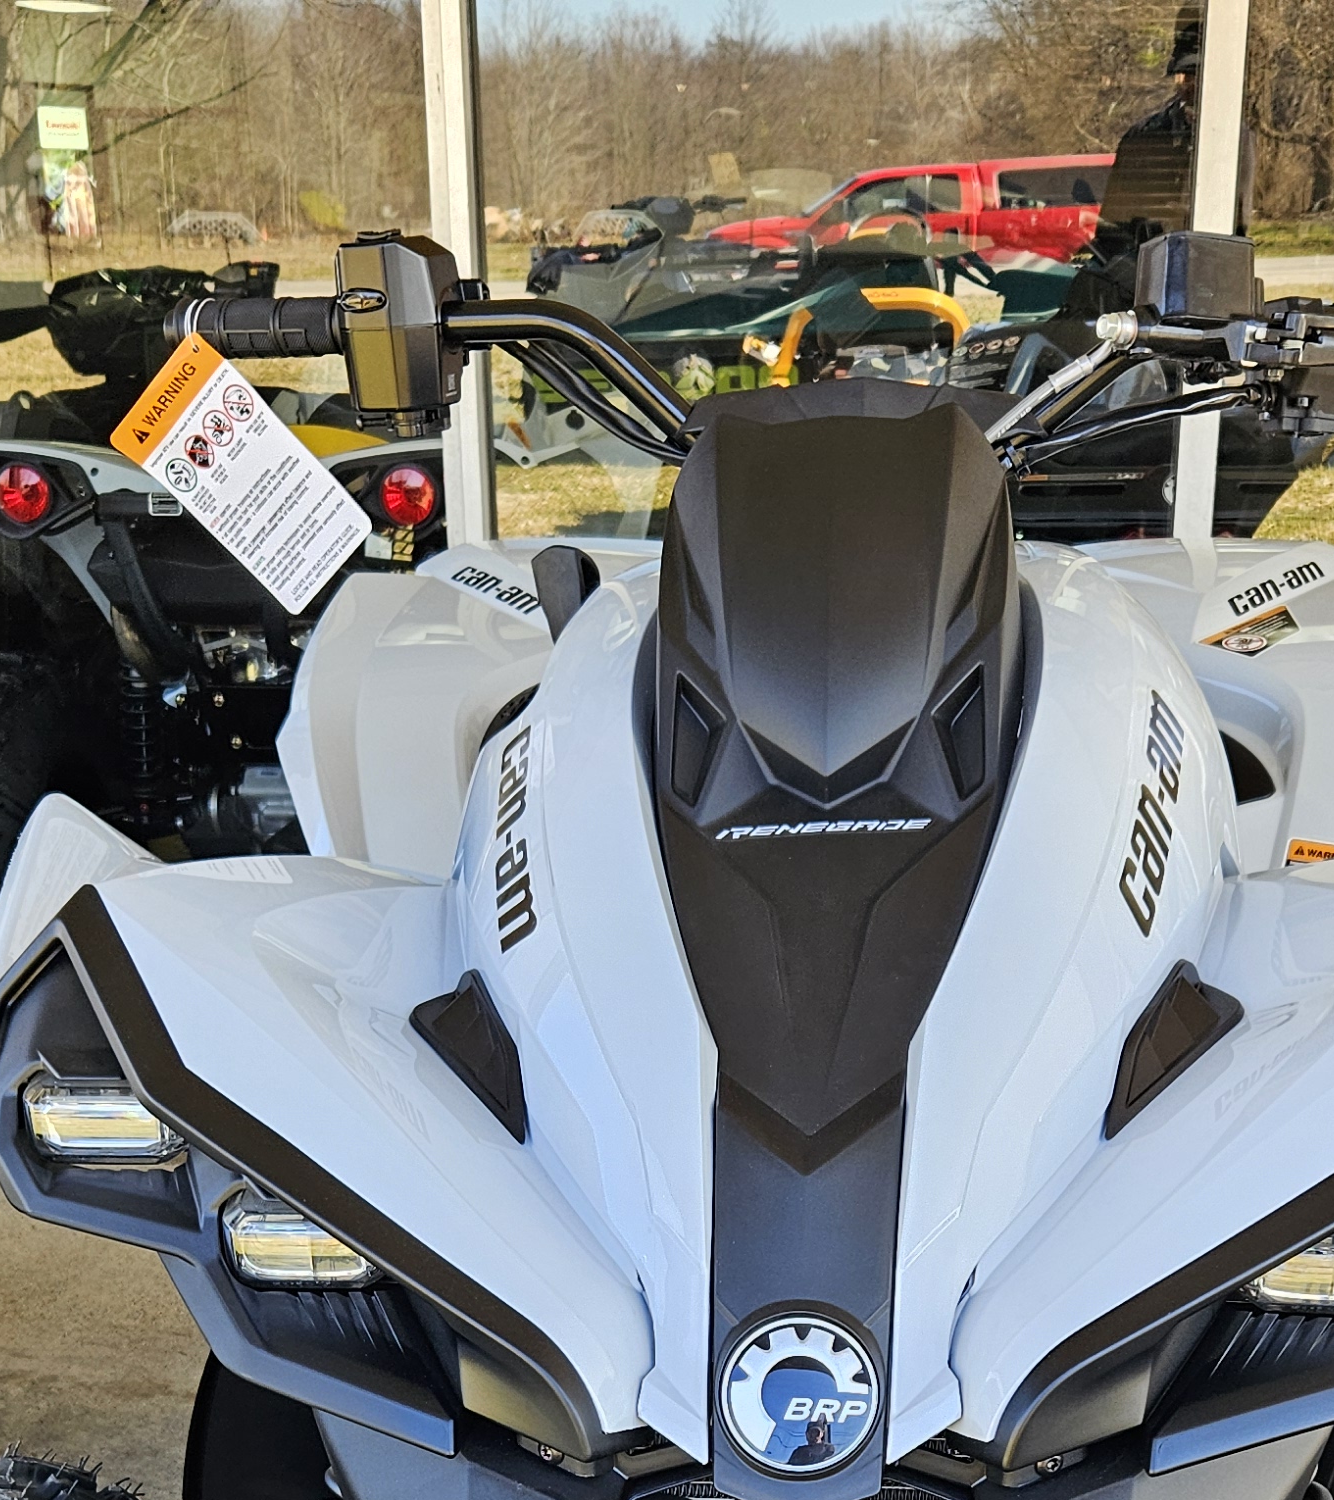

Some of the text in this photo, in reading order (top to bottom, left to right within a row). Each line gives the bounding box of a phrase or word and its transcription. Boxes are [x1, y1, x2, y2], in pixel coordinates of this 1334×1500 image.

[142, 362, 197, 427] WARNING
[451, 566, 541, 614] can-am
[1228, 561, 1325, 616] can-am
[496, 725, 540, 952] can-am
[714, 817, 932, 841] RENEGADE
[1119, 689, 1189, 938] can-am
[783, 1396, 868, 1424] BRP
